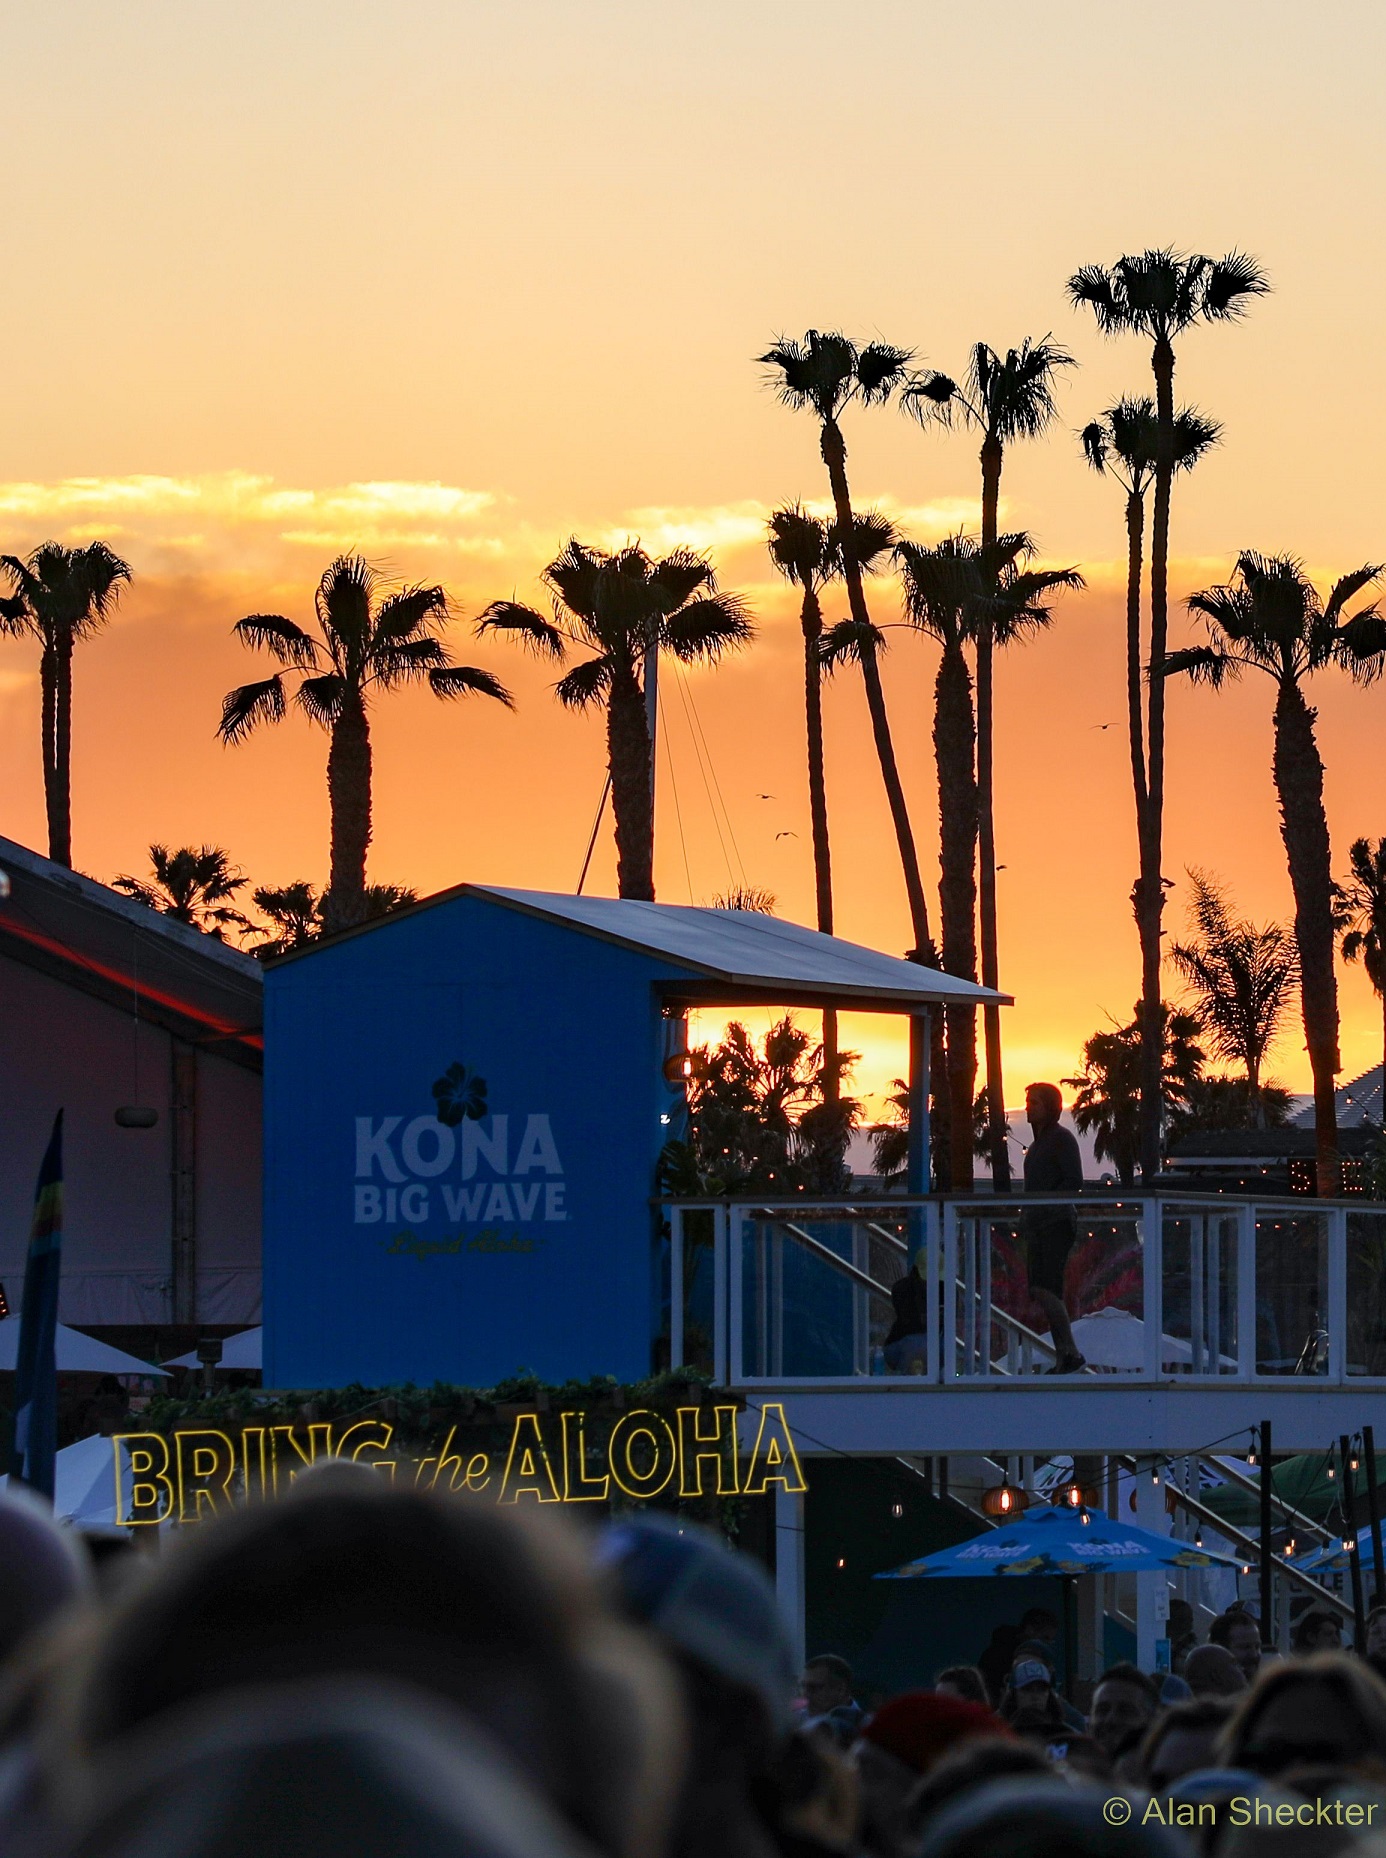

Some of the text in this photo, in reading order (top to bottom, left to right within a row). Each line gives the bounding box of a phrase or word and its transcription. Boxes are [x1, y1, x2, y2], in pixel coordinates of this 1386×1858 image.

[354, 1113, 565, 1183] KONA
[354, 1182, 568, 1224] BIG WAVE
[498, 1402, 809, 1505] ALOHA
